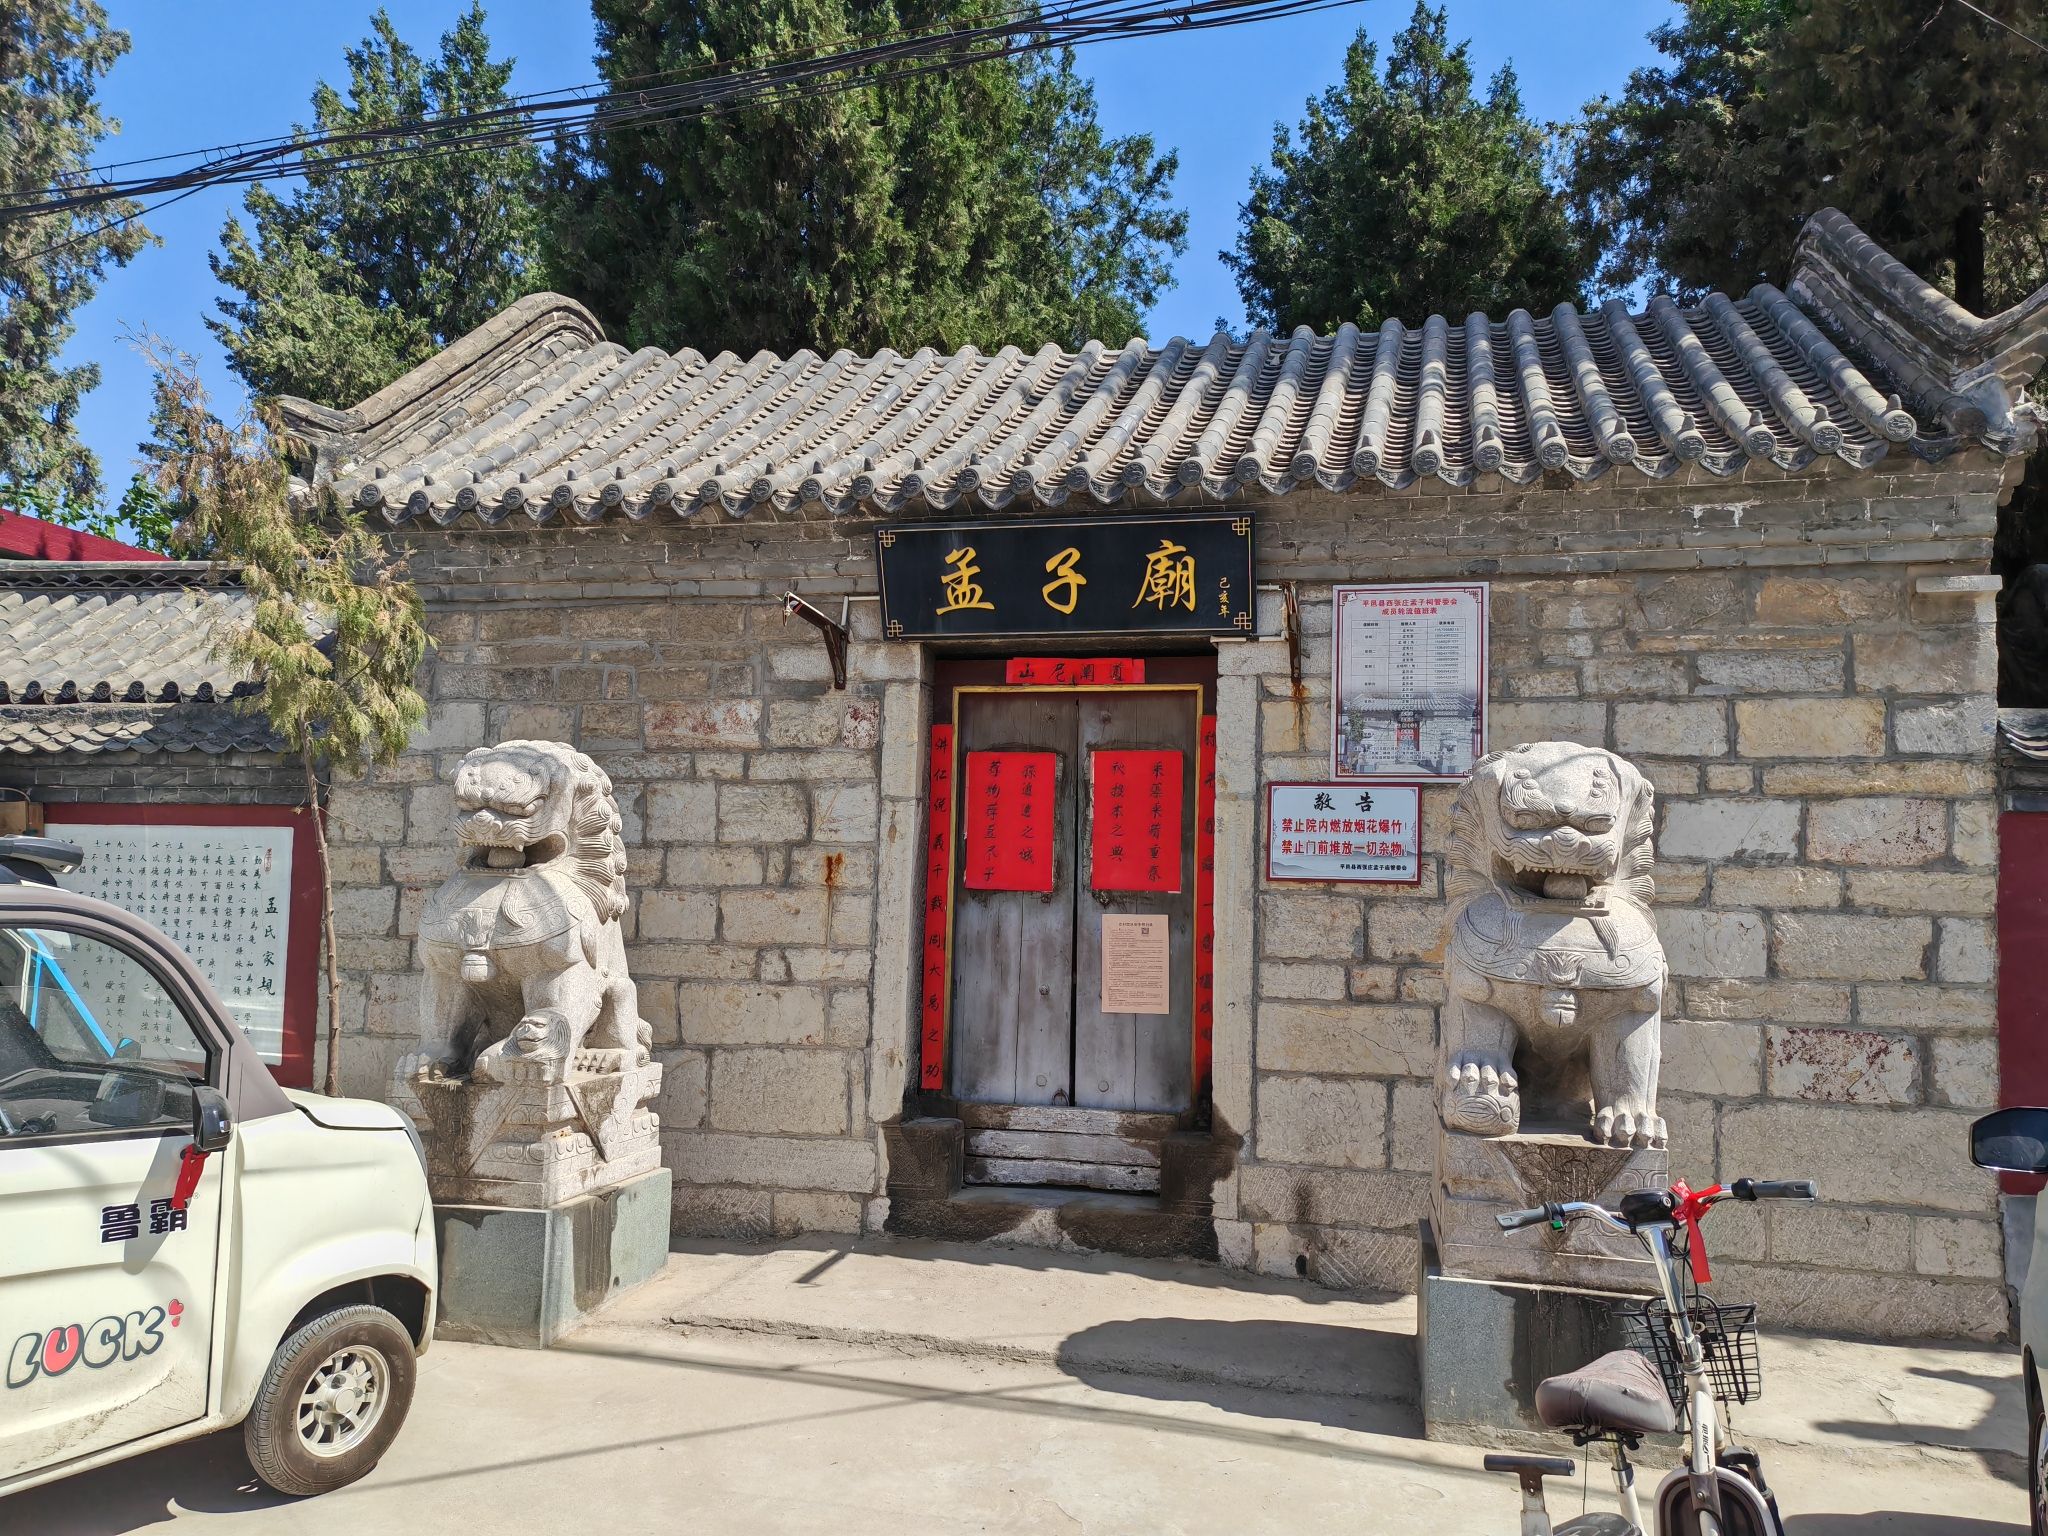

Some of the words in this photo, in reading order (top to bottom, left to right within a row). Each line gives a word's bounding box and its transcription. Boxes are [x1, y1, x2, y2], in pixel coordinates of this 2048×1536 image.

[936, 539, 1196, 615] 孟子廟
[1313, 791, 1375, 813] 敬告
[6, 1305, 167, 1389] LUCK
